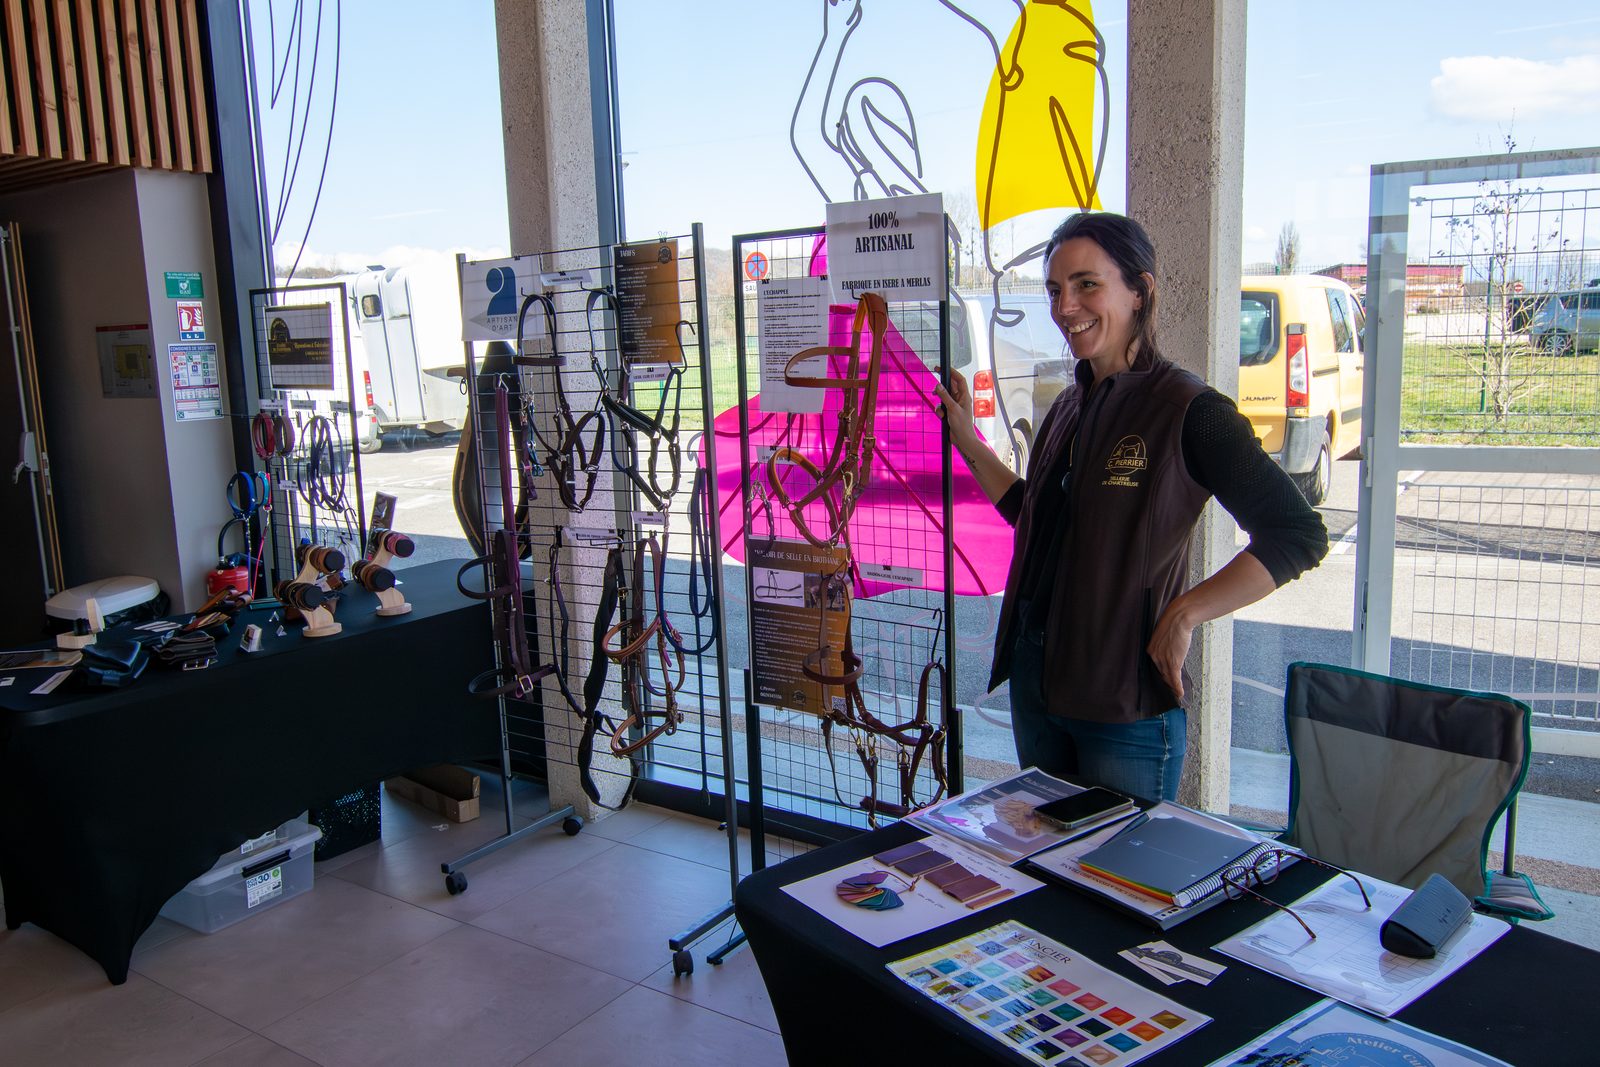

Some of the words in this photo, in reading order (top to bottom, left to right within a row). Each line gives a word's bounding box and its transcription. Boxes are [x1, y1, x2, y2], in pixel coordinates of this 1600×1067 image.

[868, 211, 899, 229] 100%
[855, 233, 914, 253] ARTISANAL
[620, 249, 636, 258] TARIFS
[842, 280, 872, 290] FABRIQUE
[873, 279, 881, 289] EN
[882, 278, 899, 288] ISERE
[900, 278, 905, 287] A
[906, 277, 931, 287] MERLAS
[487, 316, 519, 324] ARTISAN
[492, 324, 512, 332] D'ART
[1114, 459, 1144, 468] PERRIER
[777, 551, 786, 560] DE
[786, 552, 802, 562] SELLE
[803, 554, 812, 563] EN
[258, 873, 269, 884] 30
[1012, 931, 1071, 964] NUANCIER
[1347, 1036, 1401, 1054] Atelier
